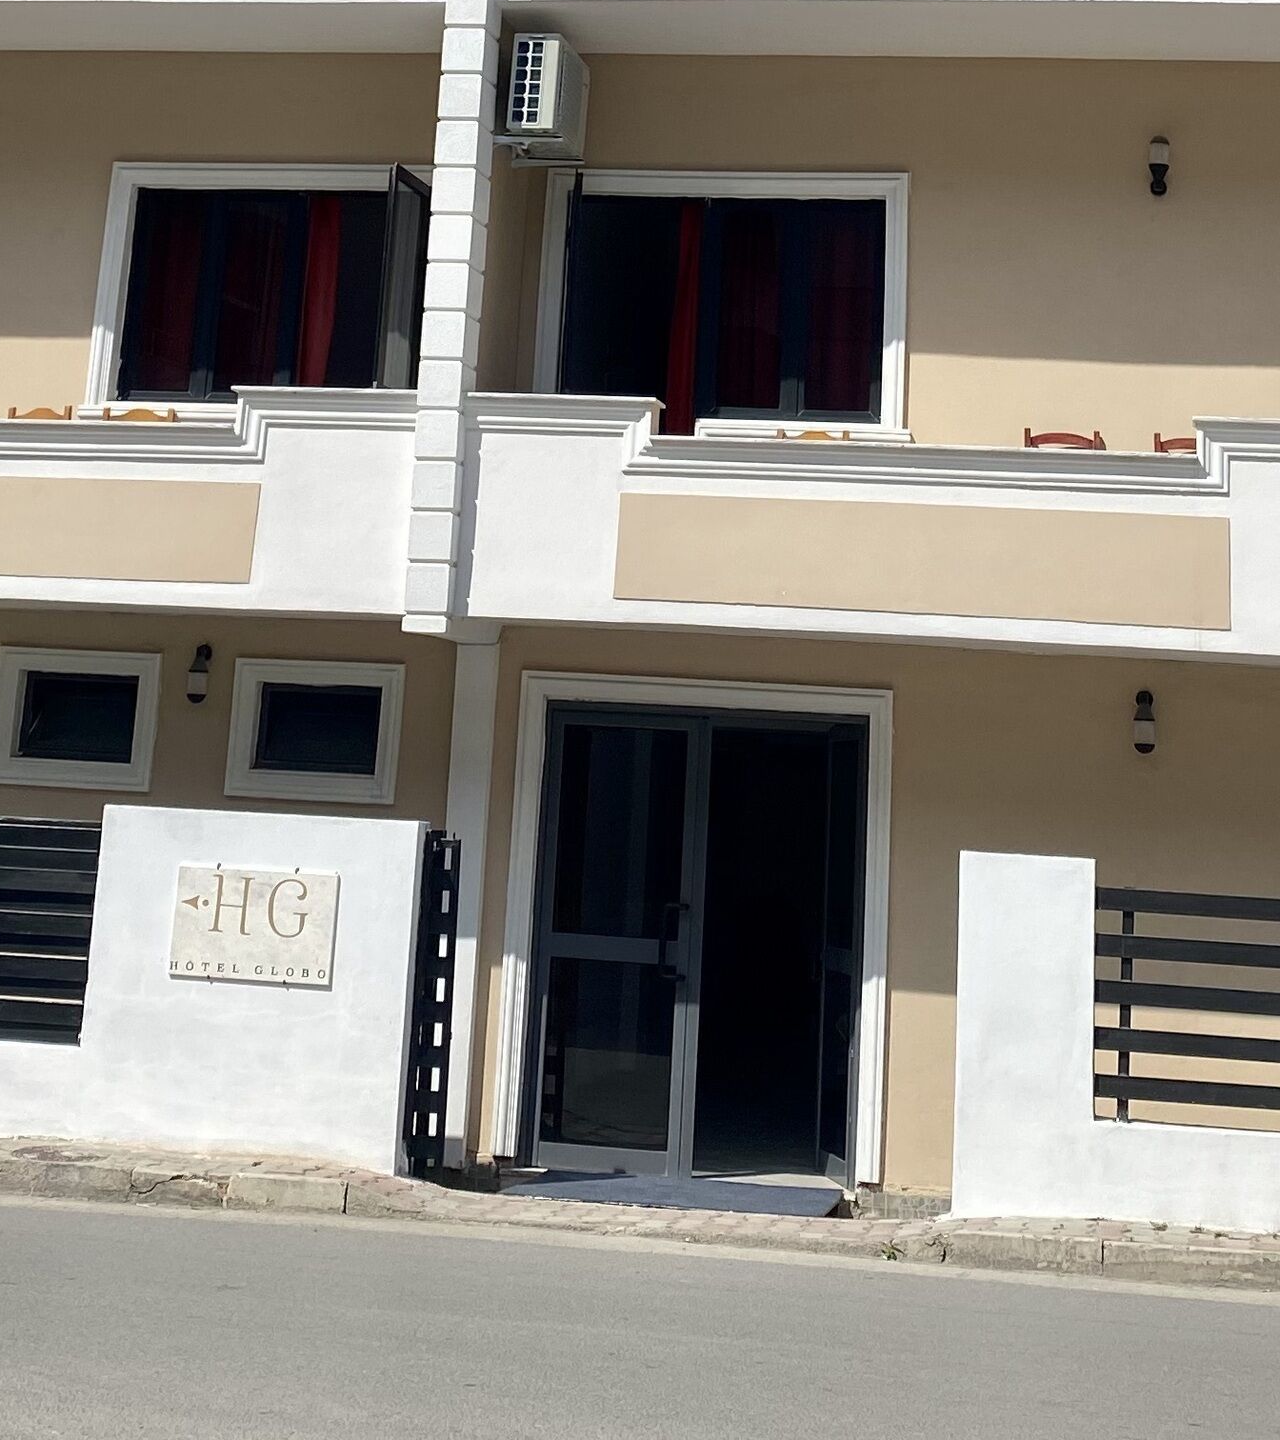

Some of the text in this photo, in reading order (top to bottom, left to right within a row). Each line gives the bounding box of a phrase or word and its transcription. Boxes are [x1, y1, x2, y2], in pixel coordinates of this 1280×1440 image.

[208, 874, 308, 938] HG
[169, 960, 326, 979] HOTEL GLOBO
